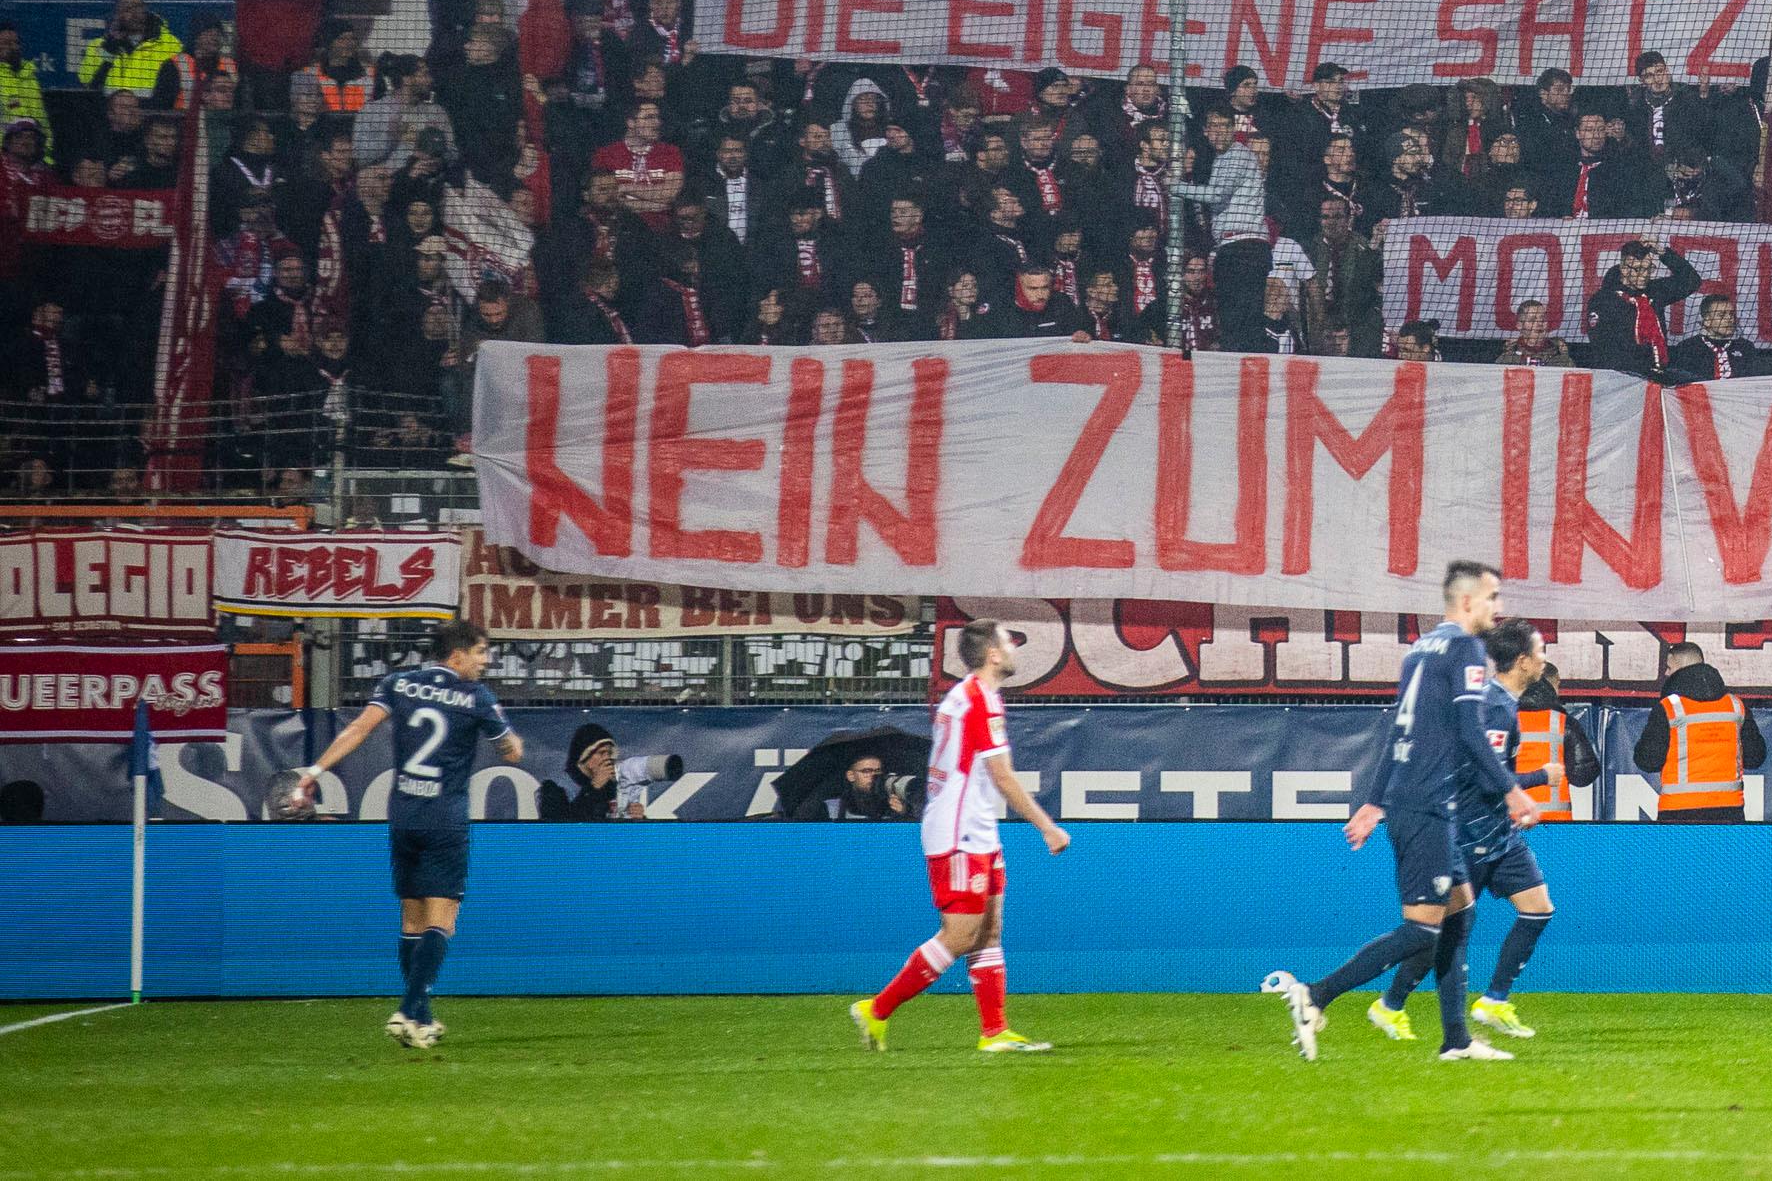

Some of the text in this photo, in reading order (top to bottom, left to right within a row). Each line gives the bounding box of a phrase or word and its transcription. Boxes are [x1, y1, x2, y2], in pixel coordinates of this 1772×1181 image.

[523, 346, 952, 569] NEIN
[1019, 349, 1427, 577] ZUM
[243, 544, 437, 602] REBELS
[467, 581, 906, 630] IMMER BEI UNS
[394, 678, 476, 709] BOCHUM
[1395, 658, 1425, 736] 4
[404, 707, 448, 778] 2
